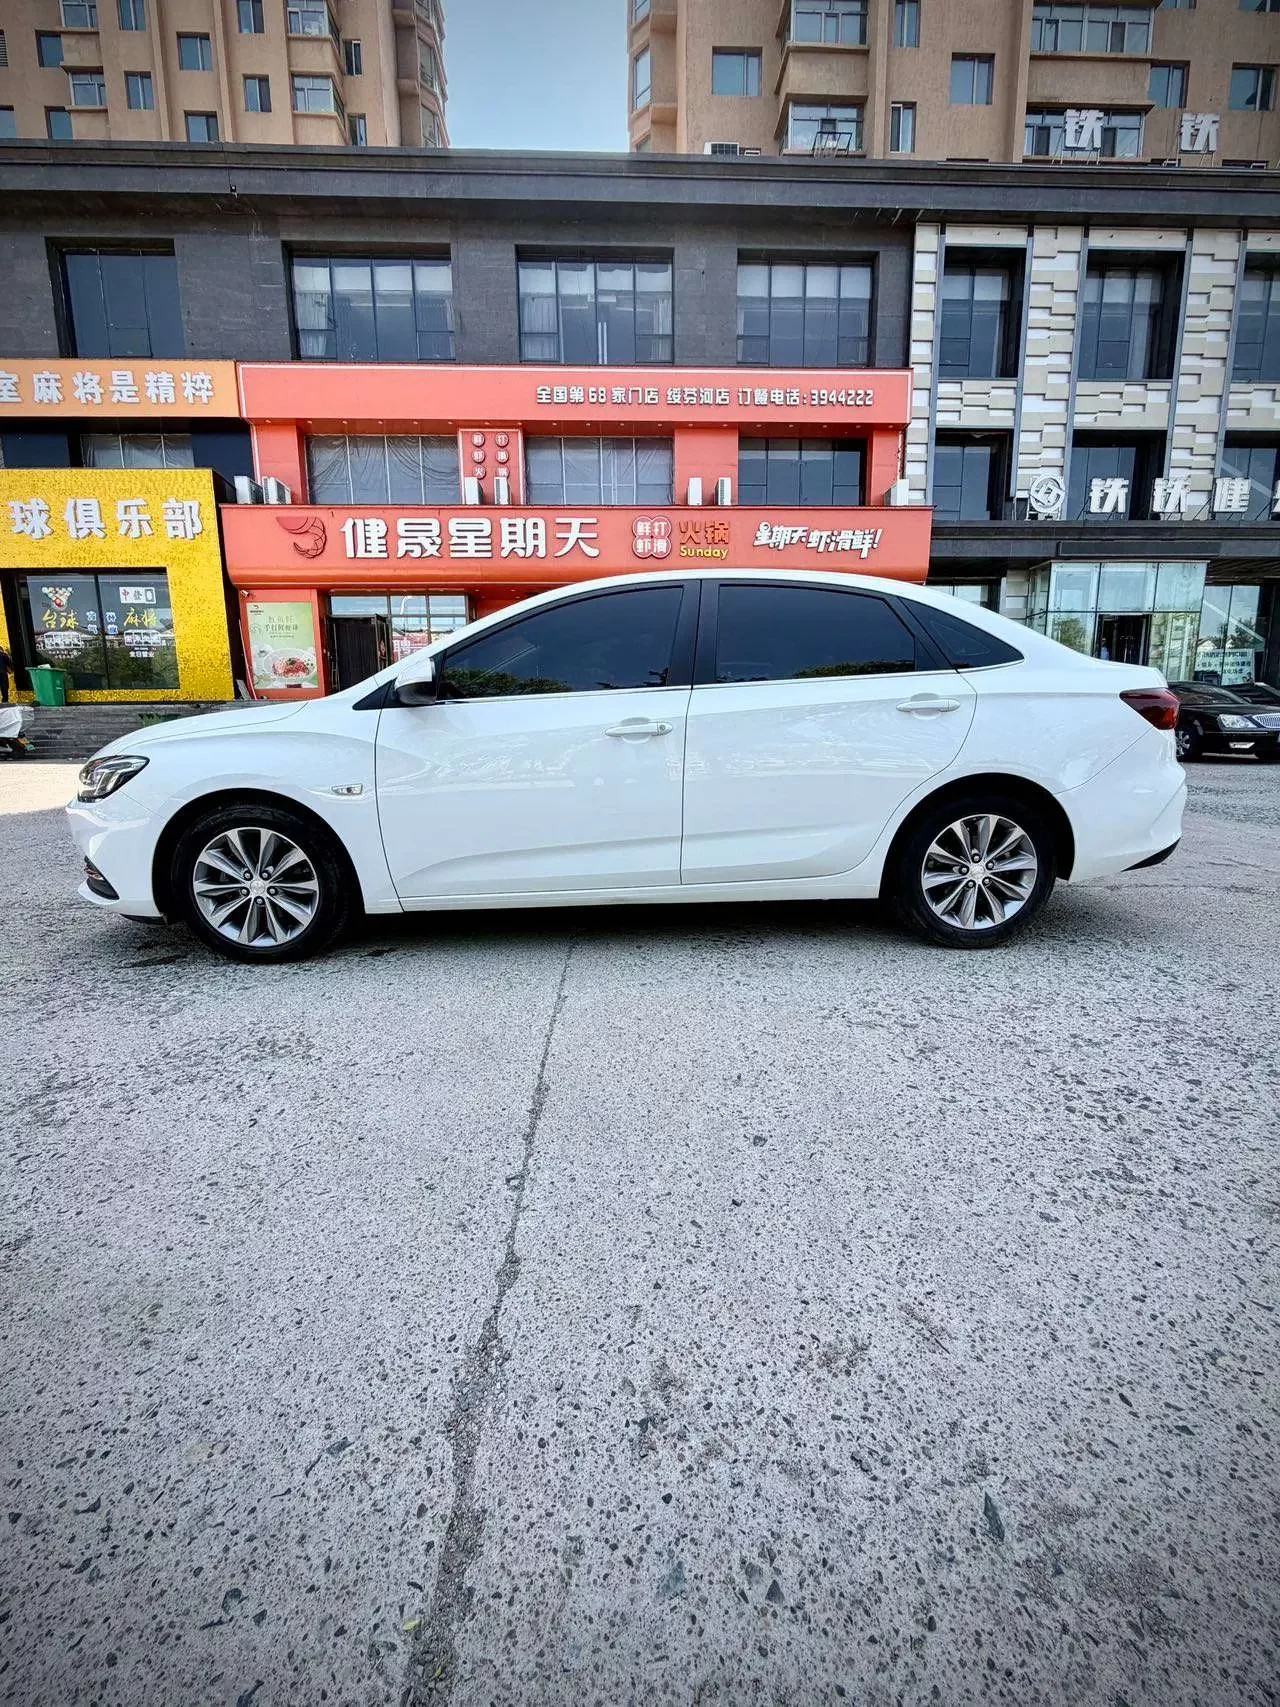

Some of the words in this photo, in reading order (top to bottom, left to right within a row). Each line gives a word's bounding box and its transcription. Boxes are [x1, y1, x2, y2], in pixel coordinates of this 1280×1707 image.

[0, 371, 214, 404] 室麻将是精粹
[536, 386, 585, 404] 全国第
[588, 388, 606, 404] 68
[611, 387, 659, 404] 家门店
[667, 388, 730, 406] 绥芬河店
[10, 498, 204, 540] 球俱乐部
[678, 520, 730, 545] 火锅
[340, 516, 600, 559] 健晟星期天
[680, 545, 728, 560] Sunday
